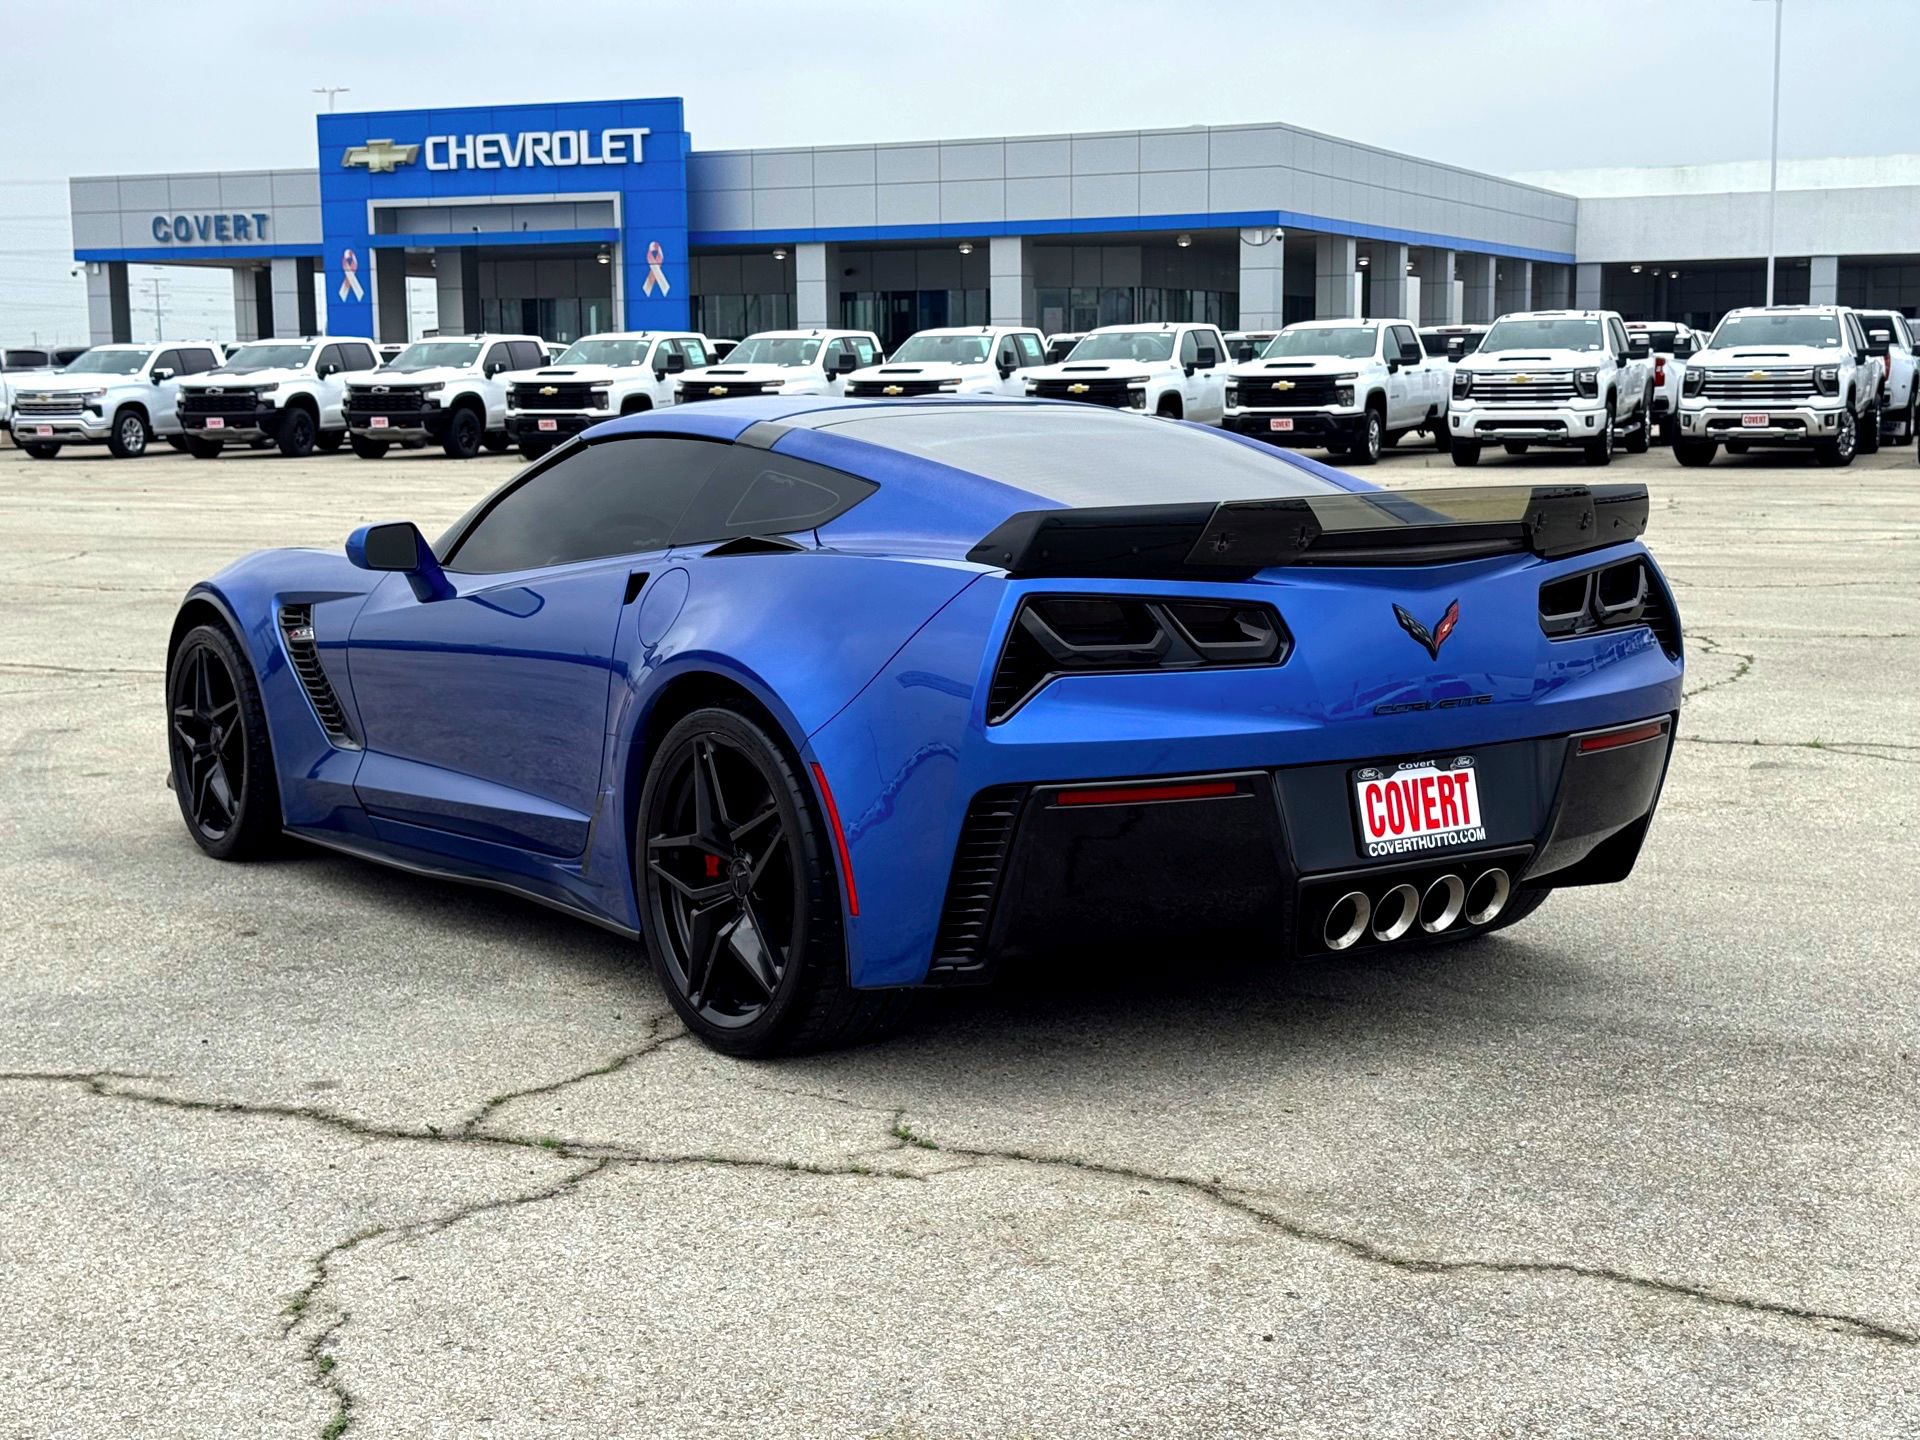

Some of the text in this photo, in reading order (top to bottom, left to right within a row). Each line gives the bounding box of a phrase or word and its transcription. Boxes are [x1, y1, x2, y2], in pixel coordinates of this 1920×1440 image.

[425, 127, 651, 171] CHEVROLET
[152, 213, 268, 242] COVERT
[1398, 760, 1436, 770] Covert
[1365, 773, 1470, 837] COVERT
[1368, 828, 1486, 856] COVERTHUTTO.COM
